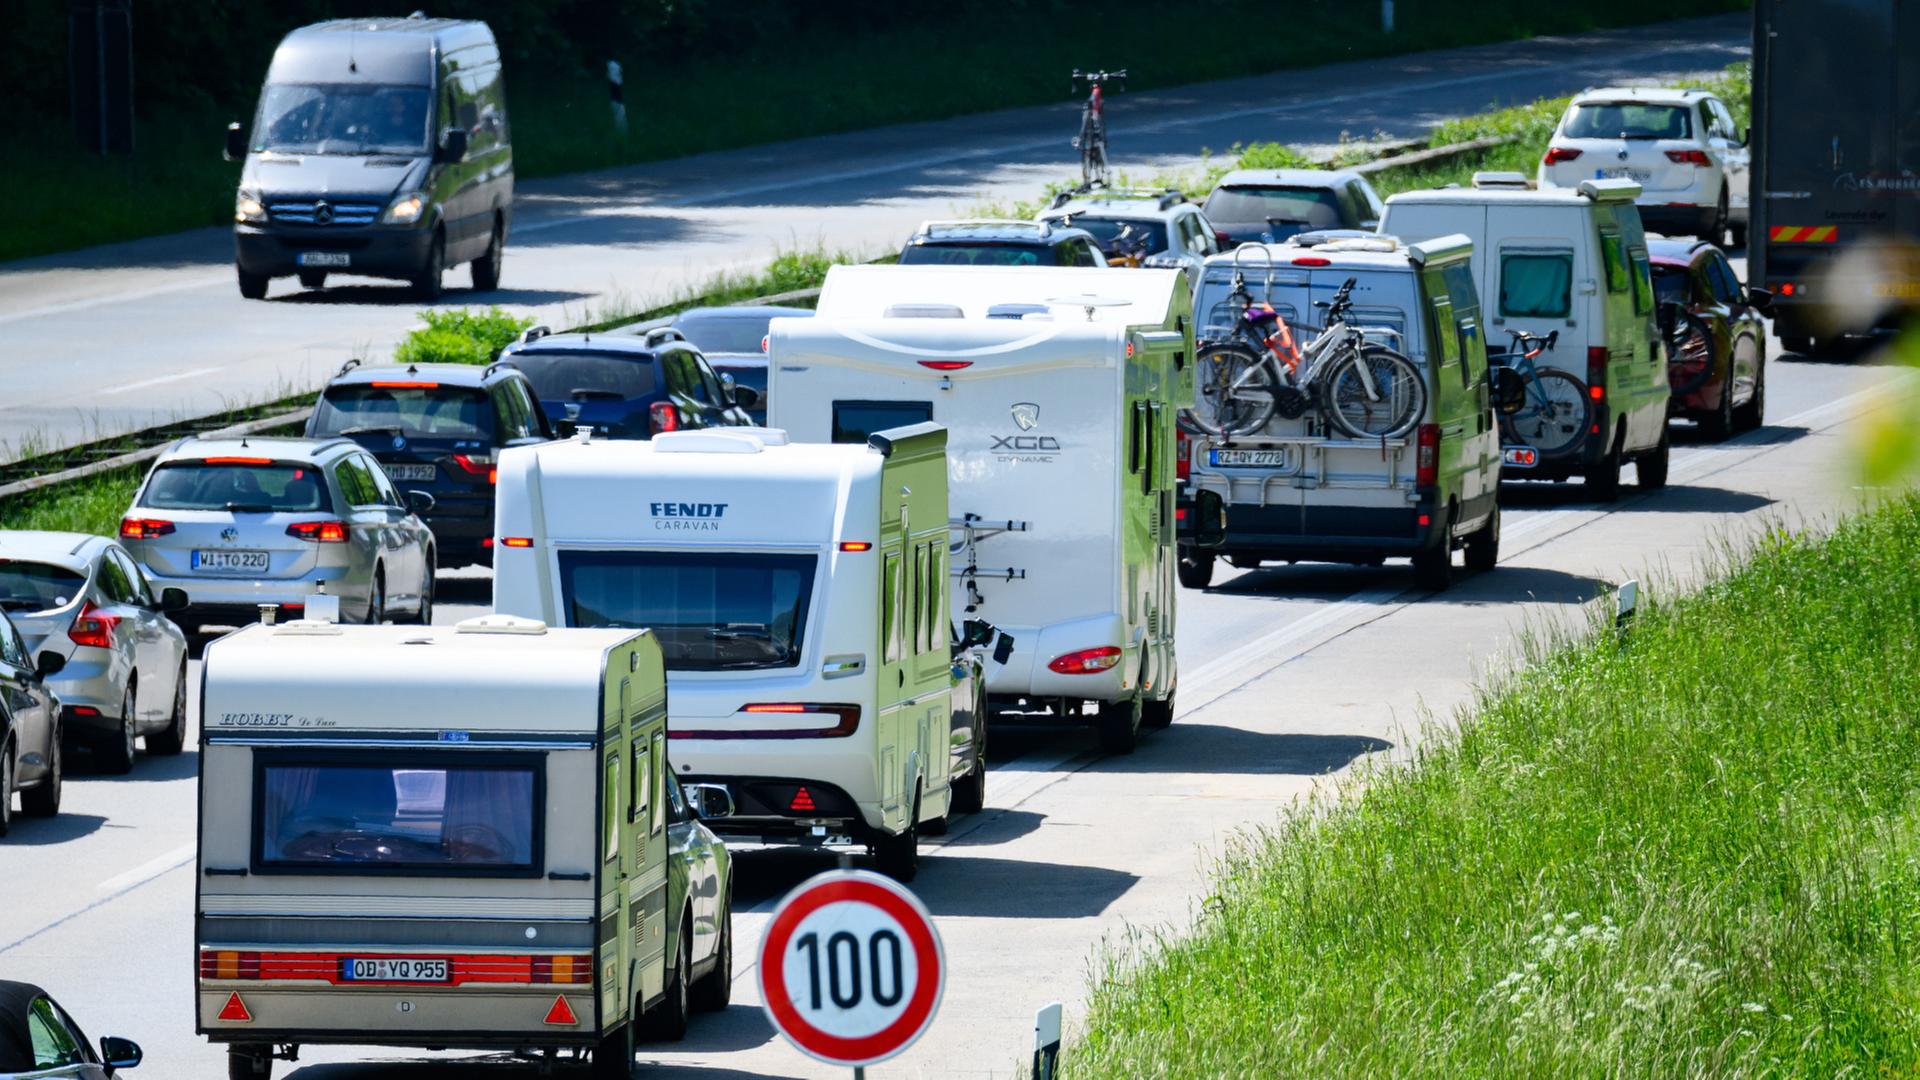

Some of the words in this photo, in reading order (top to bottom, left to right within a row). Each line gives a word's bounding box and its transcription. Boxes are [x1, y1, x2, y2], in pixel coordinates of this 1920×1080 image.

[997, 455, 1053, 464] DYNAMIC
[1217, 451, 1231, 463] RZ
[407, 466, 434, 478] 1952
[650, 503, 728, 518] FENDT
[655, 520, 719, 530] CARAVAN
[201, 554, 215, 566] WI
[242, 554, 266, 567] 220
[219, 713, 294, 726] HOBBY
[354, 961, 377, 978] OD
[389, 961, 410, 977] YQ
[414, 961, 445, 978] 955
[797, 929, 903, 1010] 100
[401, 1001, 411, 1012] D
